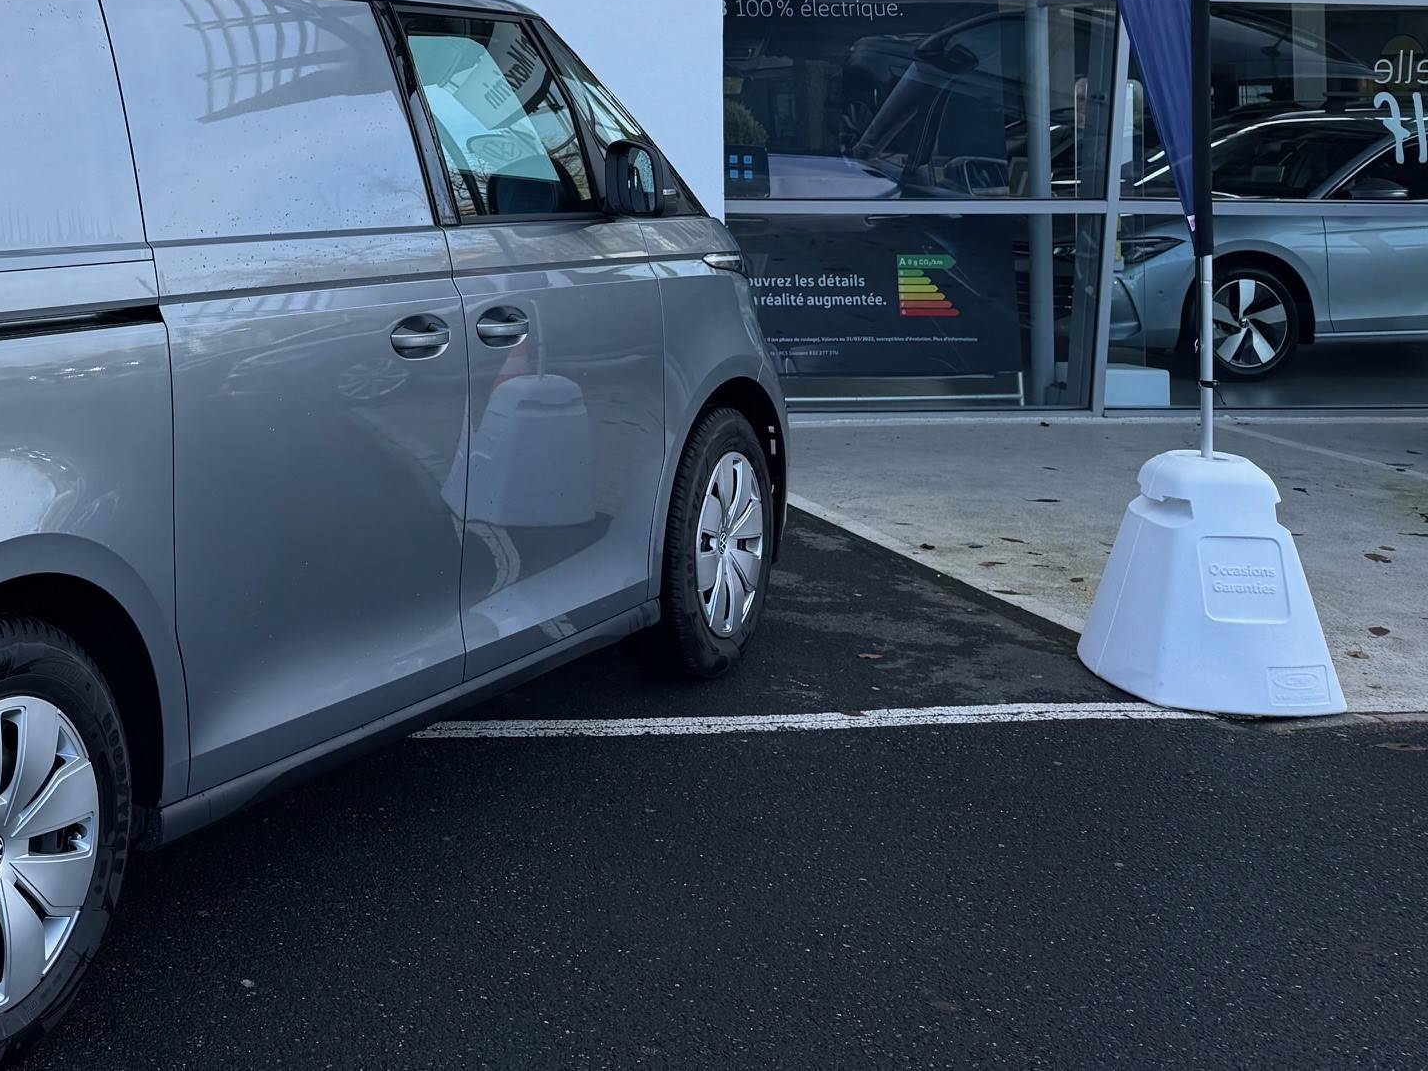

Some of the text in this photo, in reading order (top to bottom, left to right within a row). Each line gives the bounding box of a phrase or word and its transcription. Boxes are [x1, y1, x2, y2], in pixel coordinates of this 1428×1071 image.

[800, 0, 904, 21] électrique.
[795, 274, 814, 287] les
[817, 274, 866, 287] détails
[761, 292, 805, 306] réalité
[806, 293, 888, 309] augmentée.
[1208, 563, 1276, 578] Occasions
[1212, 581, 1277, 595] Garanties
